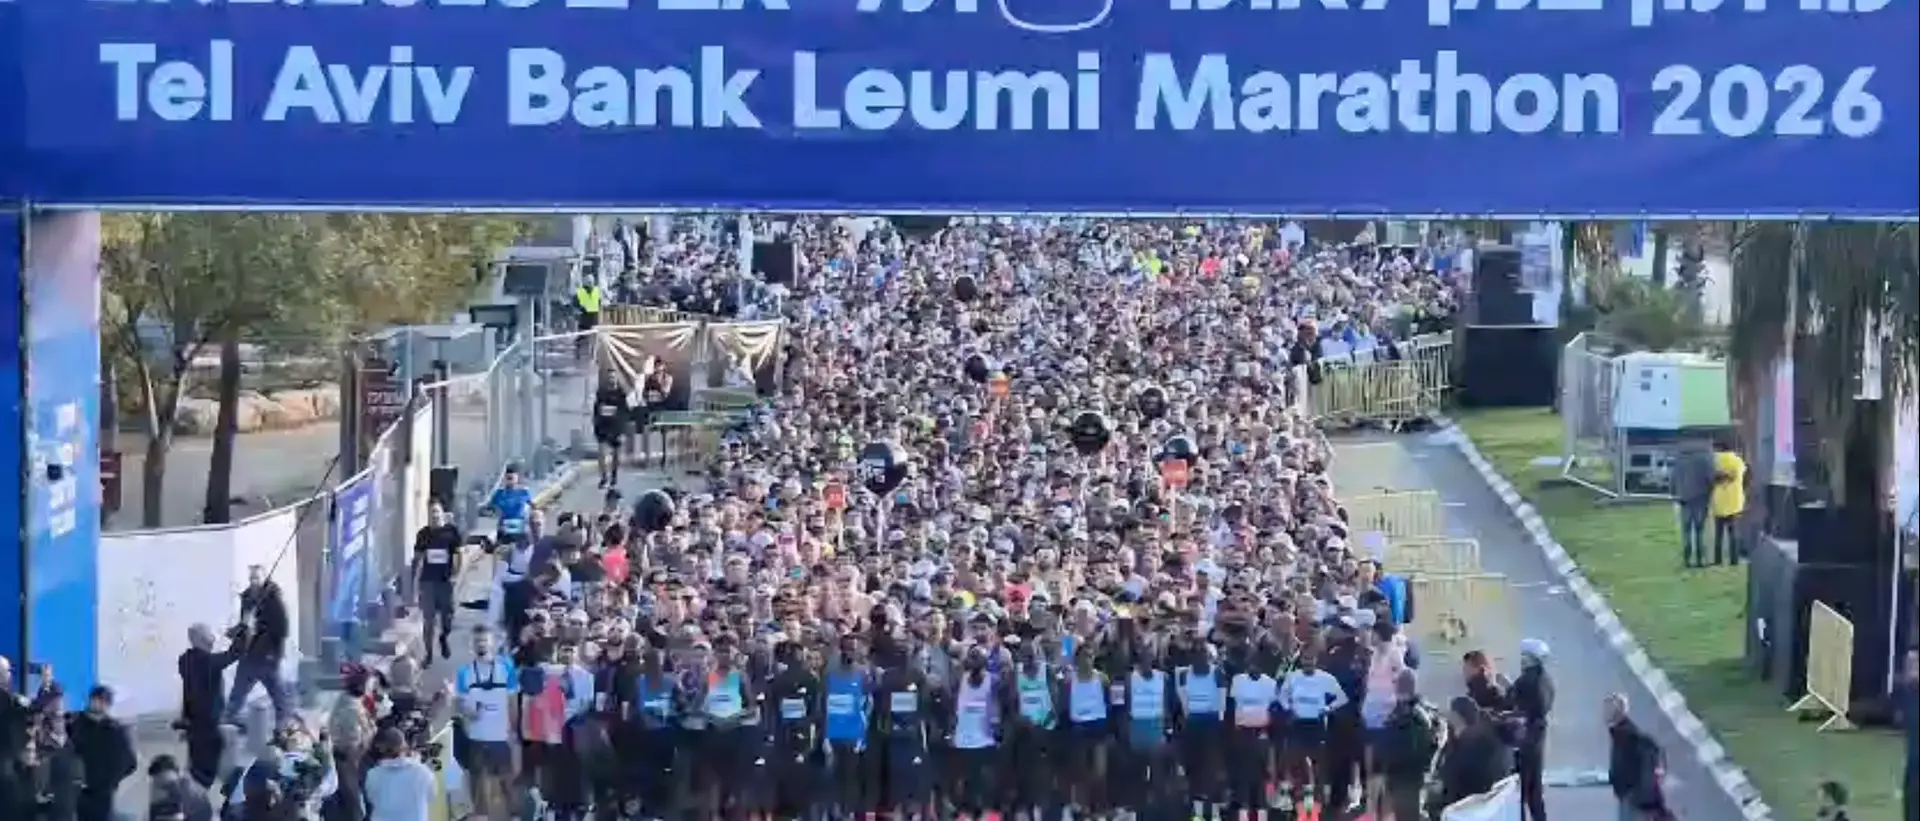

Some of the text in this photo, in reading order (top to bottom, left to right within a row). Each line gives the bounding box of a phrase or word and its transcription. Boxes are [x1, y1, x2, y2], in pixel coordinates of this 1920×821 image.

[99, 40, 1883, 138] Tel Aviv Bank Leumi Marathon 2026
